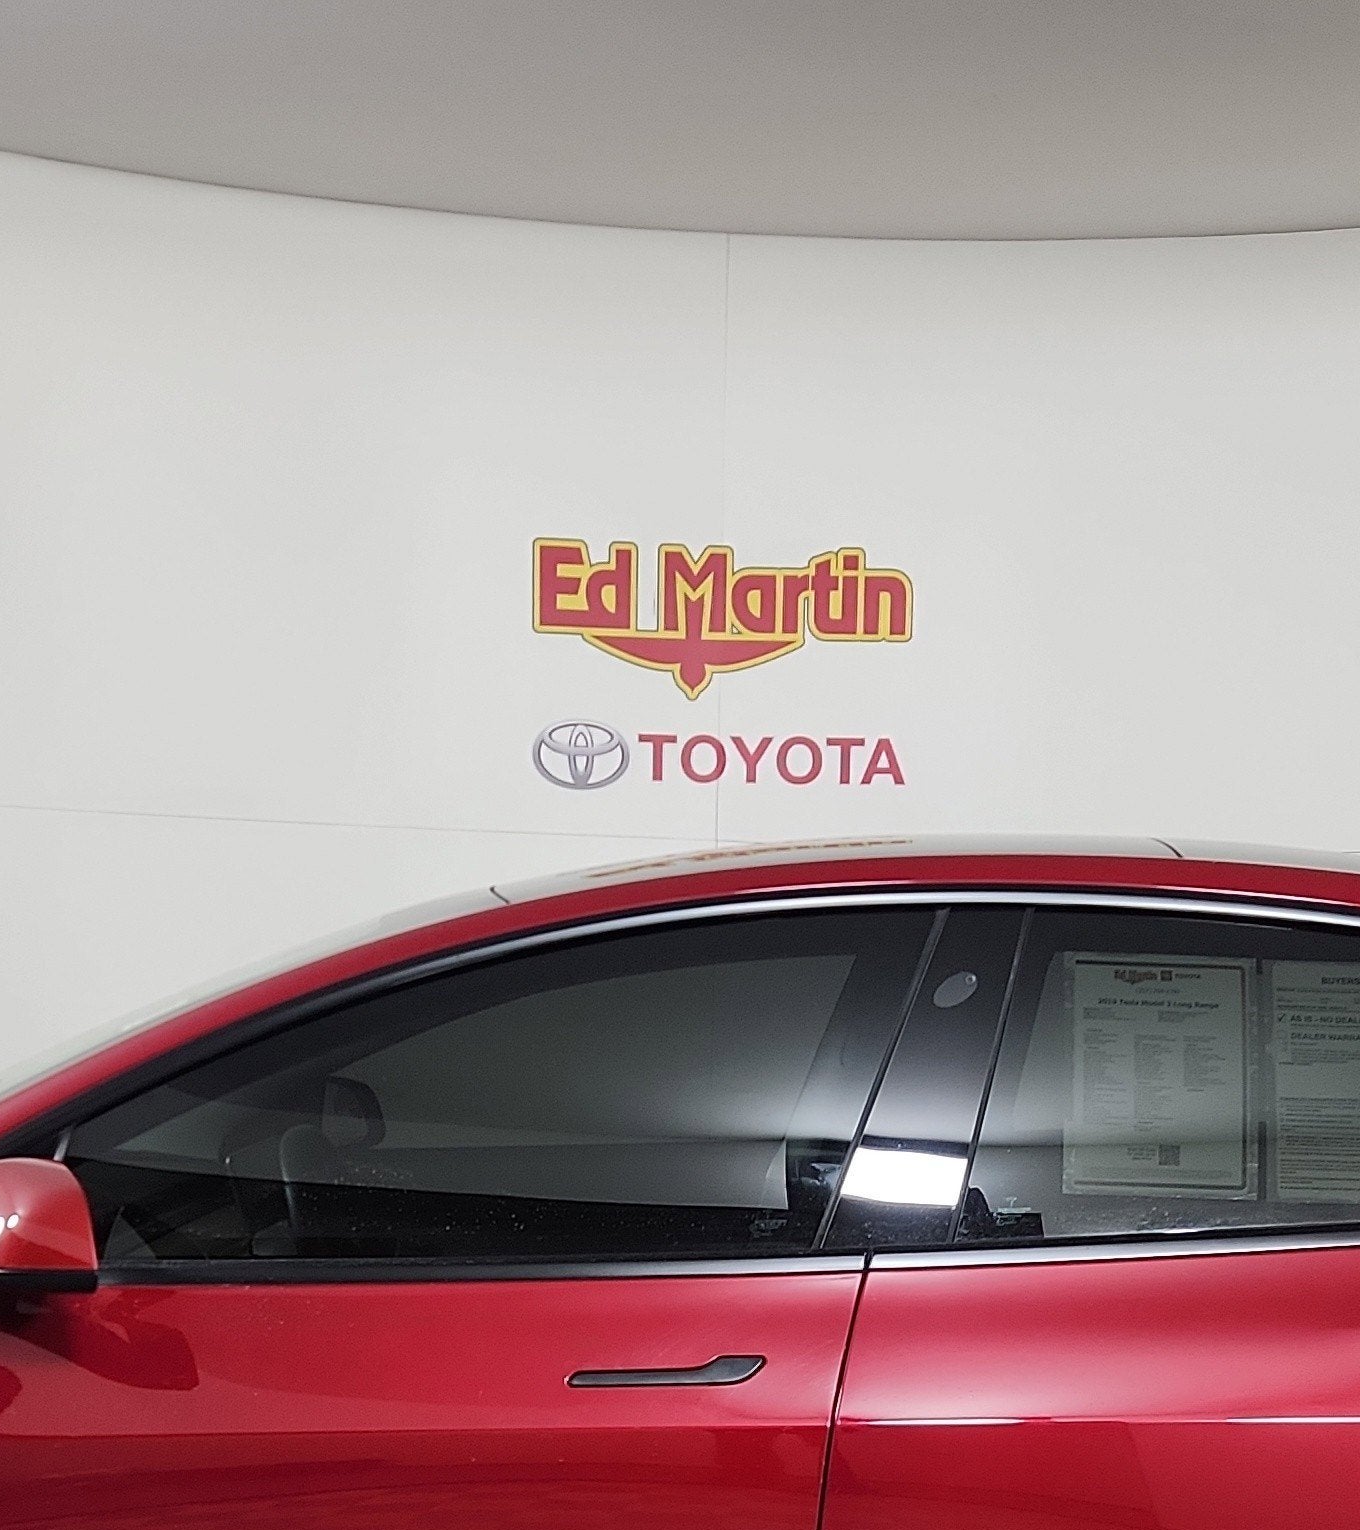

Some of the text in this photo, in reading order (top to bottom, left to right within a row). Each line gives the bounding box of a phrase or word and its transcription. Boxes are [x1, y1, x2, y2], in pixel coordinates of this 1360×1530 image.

[533, 537, 913, 641] Ed Martin
[637, 733, 906, 786] TOYOTA
